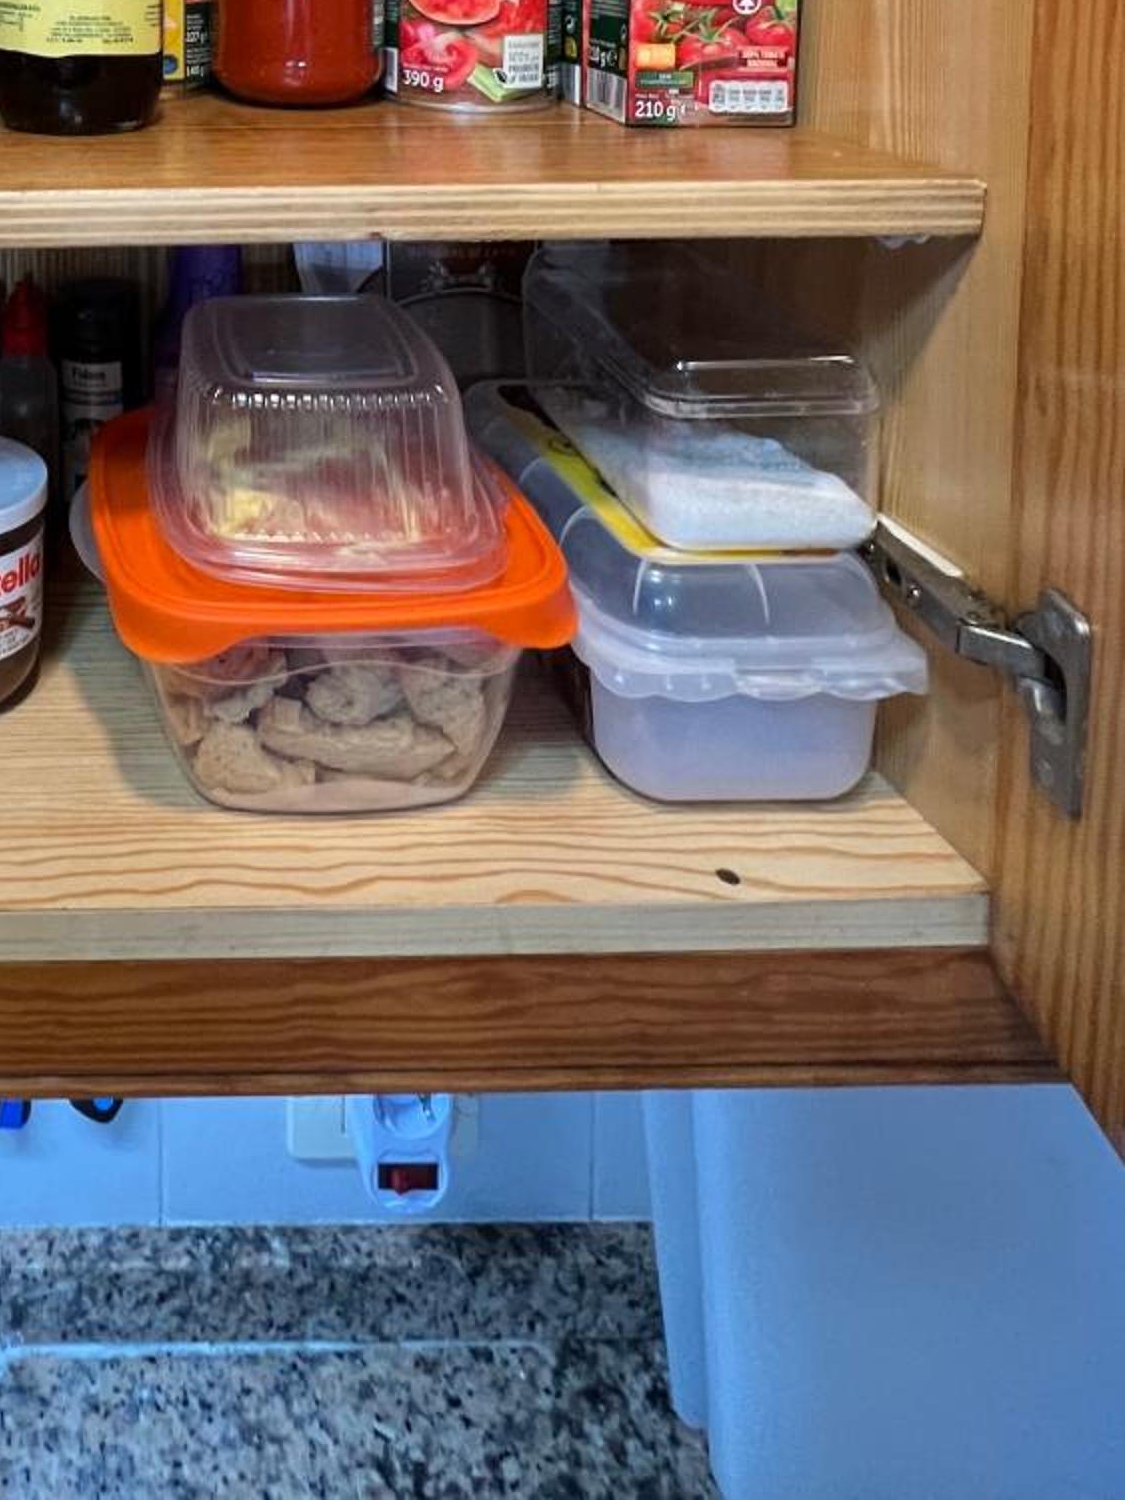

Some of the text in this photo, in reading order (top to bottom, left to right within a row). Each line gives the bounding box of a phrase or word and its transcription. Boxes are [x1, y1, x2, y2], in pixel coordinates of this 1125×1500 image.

[402, 69, 444, 93] 390 g
[634, 100, 676, 122] 210 g
